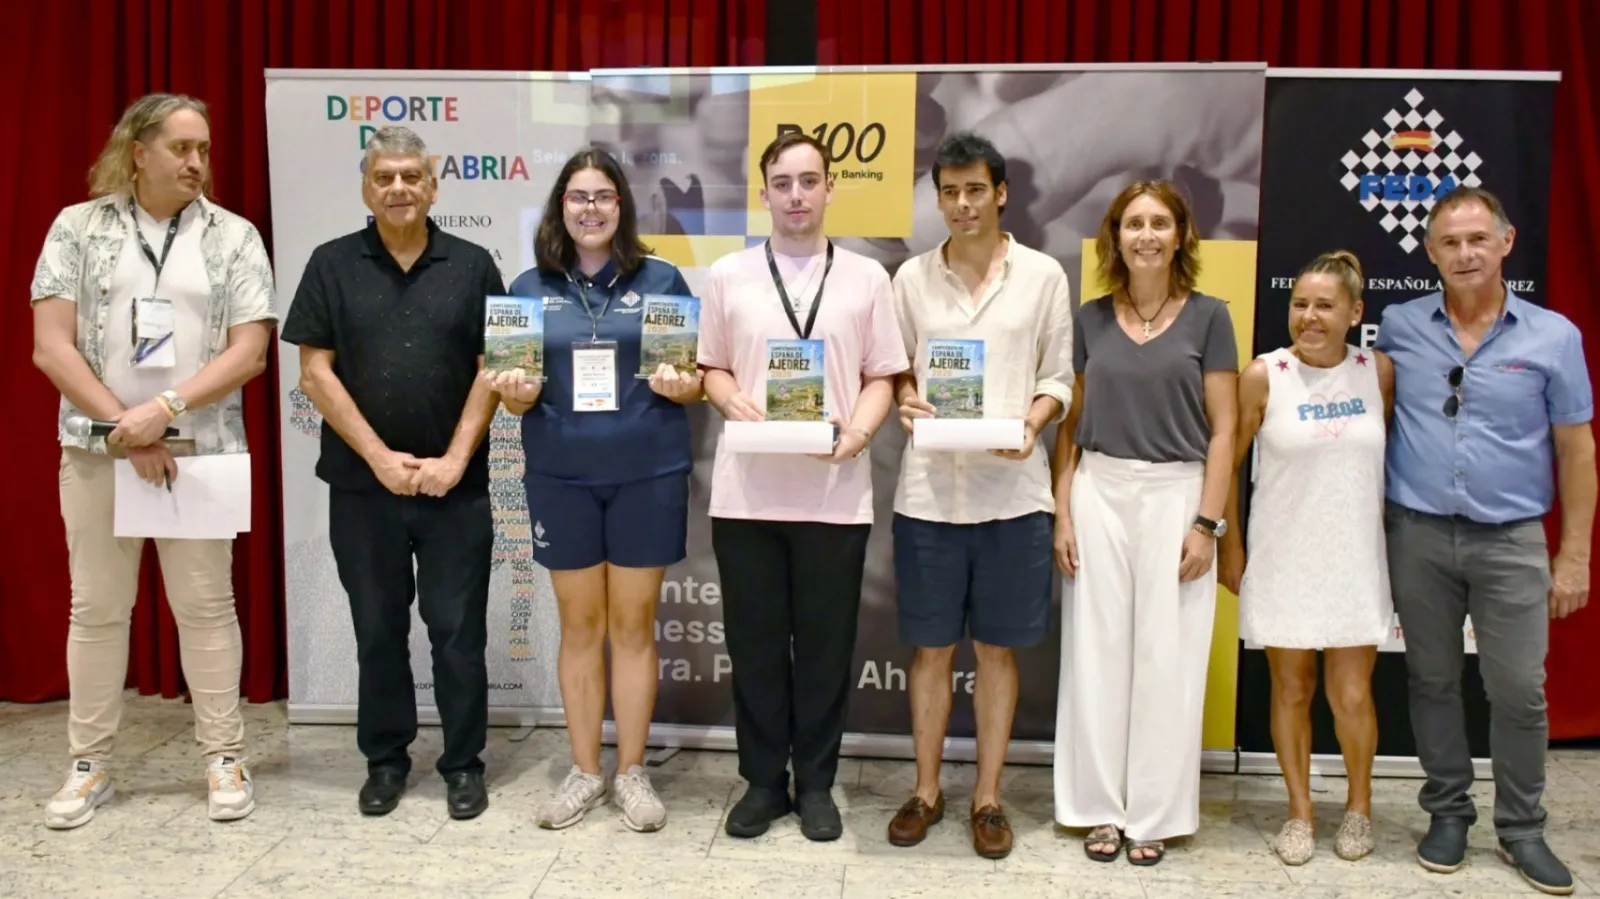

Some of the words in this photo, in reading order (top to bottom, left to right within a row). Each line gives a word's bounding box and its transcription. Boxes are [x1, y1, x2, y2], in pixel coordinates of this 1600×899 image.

[327, 95, 459, 122] DEPORTE
[842, 170, 883, 181] Banking
[1359, 174, 1457, 201] FEDA
[432, 215, 492, 228] BIERNO
[1368, 276, 1443, 291] ESPAÑOLA
[487, 315, 529, 328] AJEDREZ
[644, 314, 685, 327] AJEDREZ
[768, 358, 810, 370] AJEDREZ
[929, 358, 971, 370] AJEDREZ
[661, 575, 721, 605] nte
[658, 654, 702, 684] ra.
[857, 660, 977, 694] Ahra
